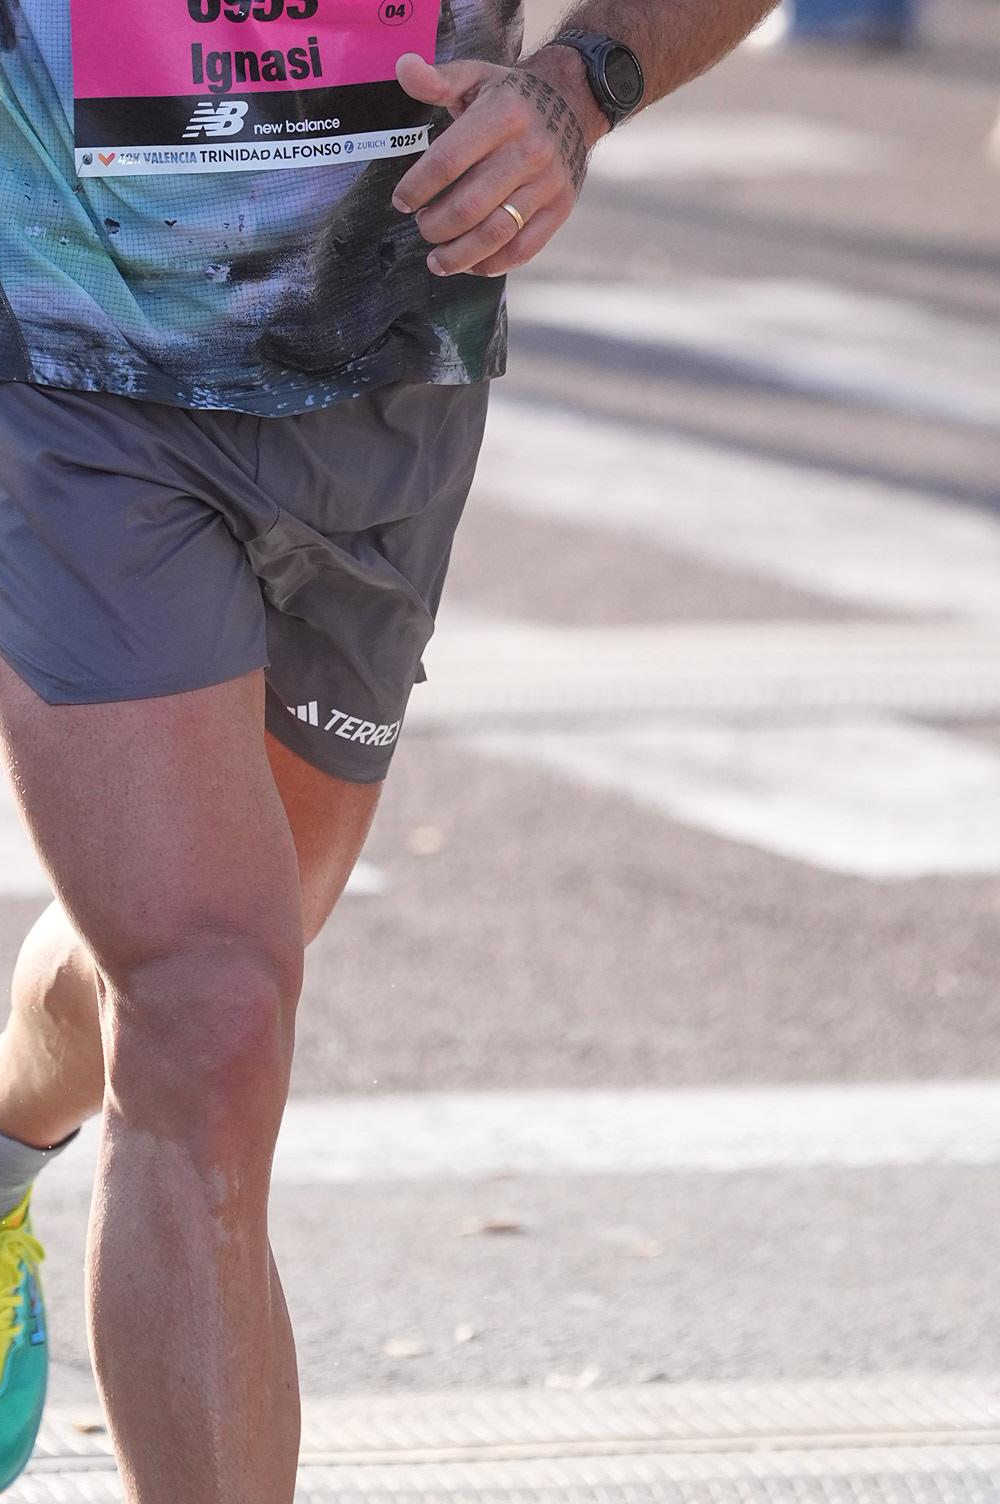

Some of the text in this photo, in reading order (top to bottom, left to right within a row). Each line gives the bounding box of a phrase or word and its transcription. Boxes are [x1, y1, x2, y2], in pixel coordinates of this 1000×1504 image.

[385, 4, 405, 18] 04
[191, 36, 323, 93] Ignasi
[253, 122, 283, 135] new
[286, 118, 340, 133] balance
[144, 151, 197, 164] VALENCIA
[200, 148, 271, 163] TRINIDAD
[273, 143, 341, 160] ALFONSO
[357, 140, 386, 150] ZURICH
[390, 134, 416, 148] 2025
